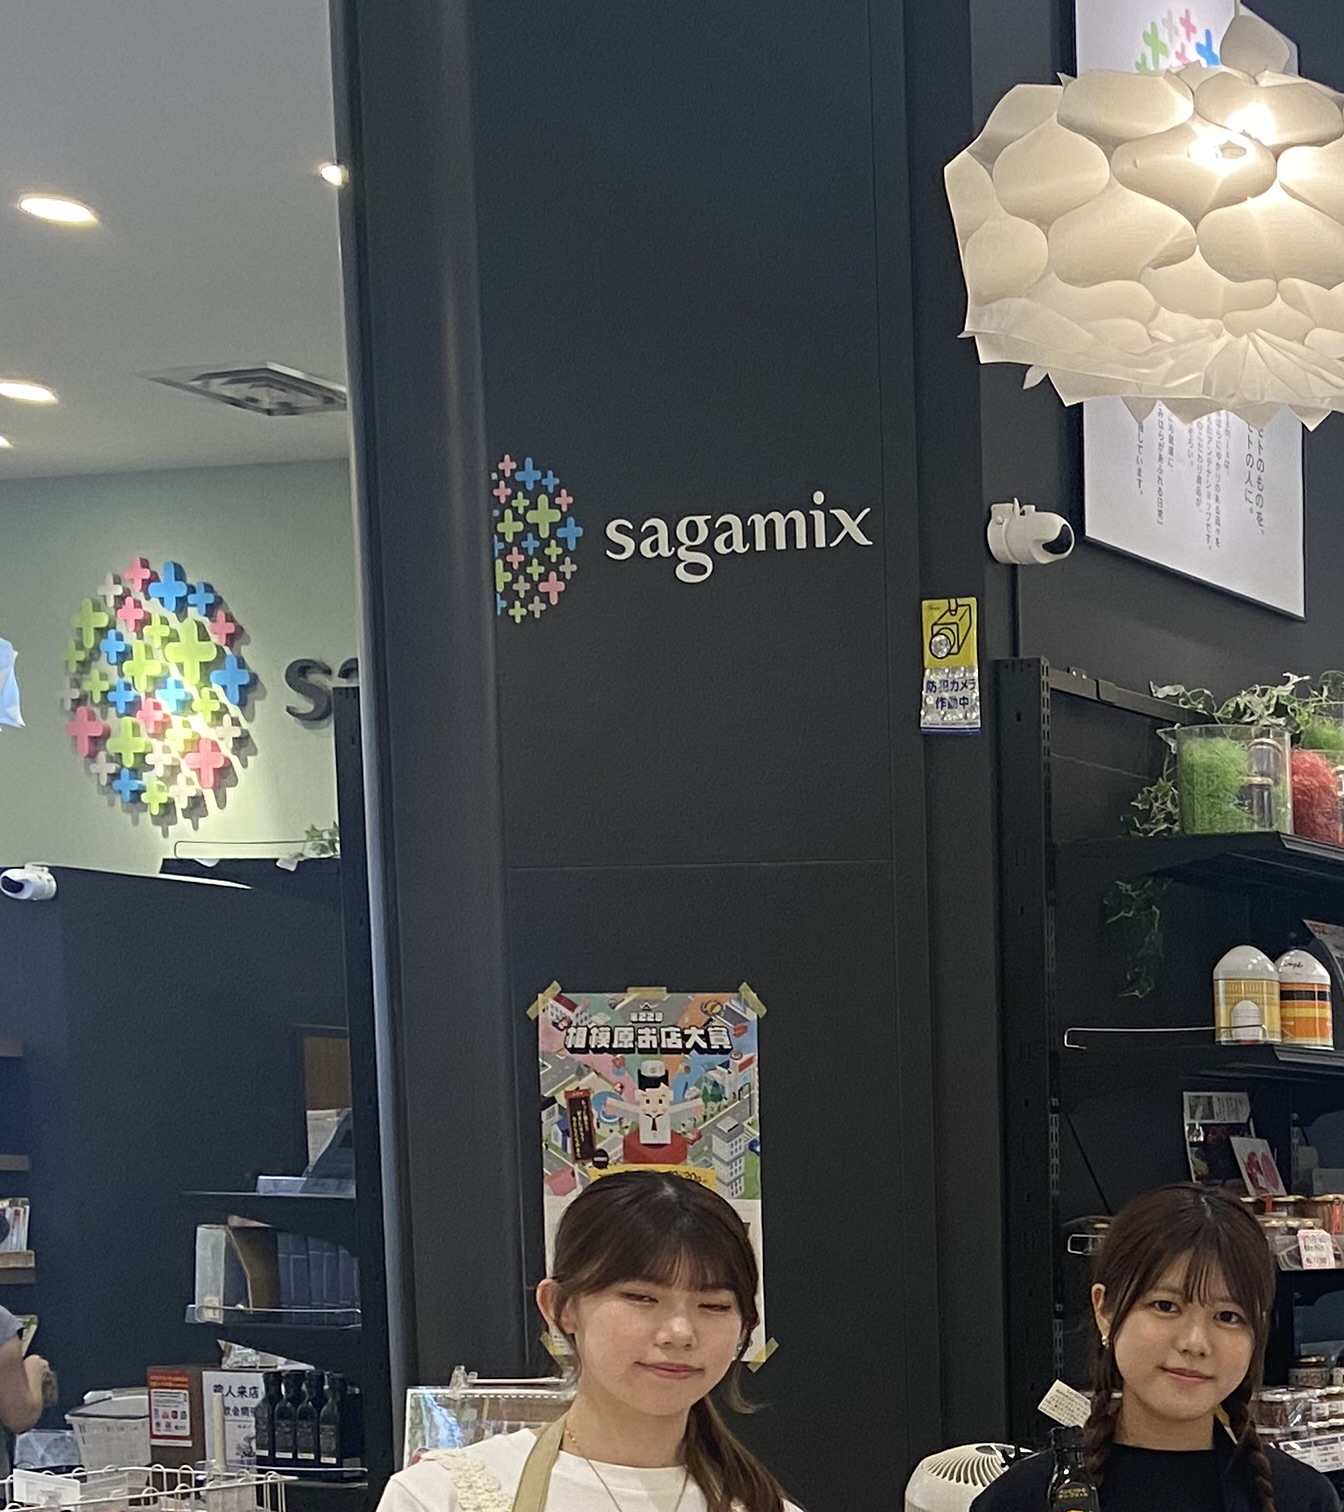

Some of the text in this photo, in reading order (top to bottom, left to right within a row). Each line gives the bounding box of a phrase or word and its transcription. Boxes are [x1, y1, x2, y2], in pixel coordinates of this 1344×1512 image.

[605, 490, 874, 584] sagamix
[925, 678, 977, 694] 防犯カメラ
[565, 1025, 734, 1053] 相模原お店大賞
